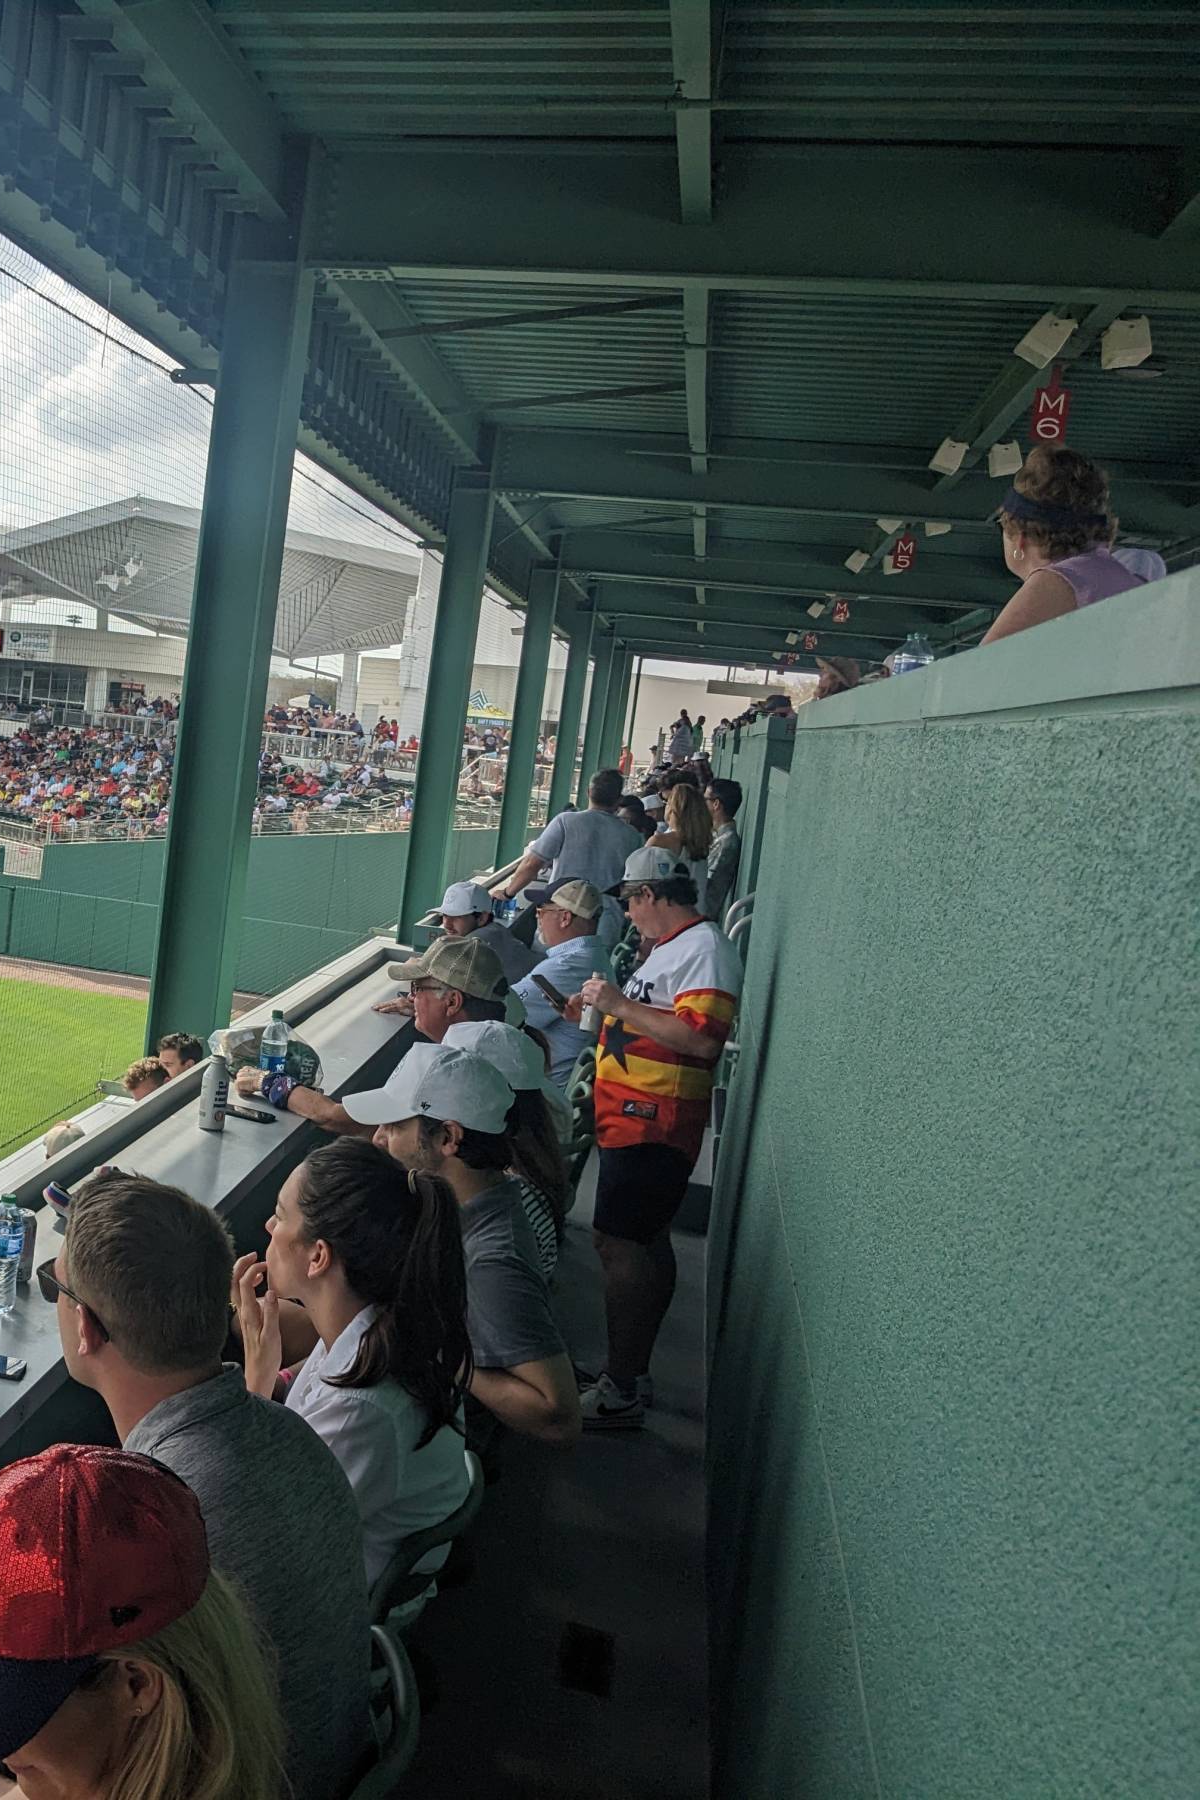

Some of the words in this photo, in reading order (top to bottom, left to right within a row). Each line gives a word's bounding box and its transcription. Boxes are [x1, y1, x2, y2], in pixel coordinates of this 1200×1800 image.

[1038, 392, 1065, 416] M
[1035, 417, 1060, 439] 6
[896, 541, 914, 554] M
[895, 555, 911, 569] 5
